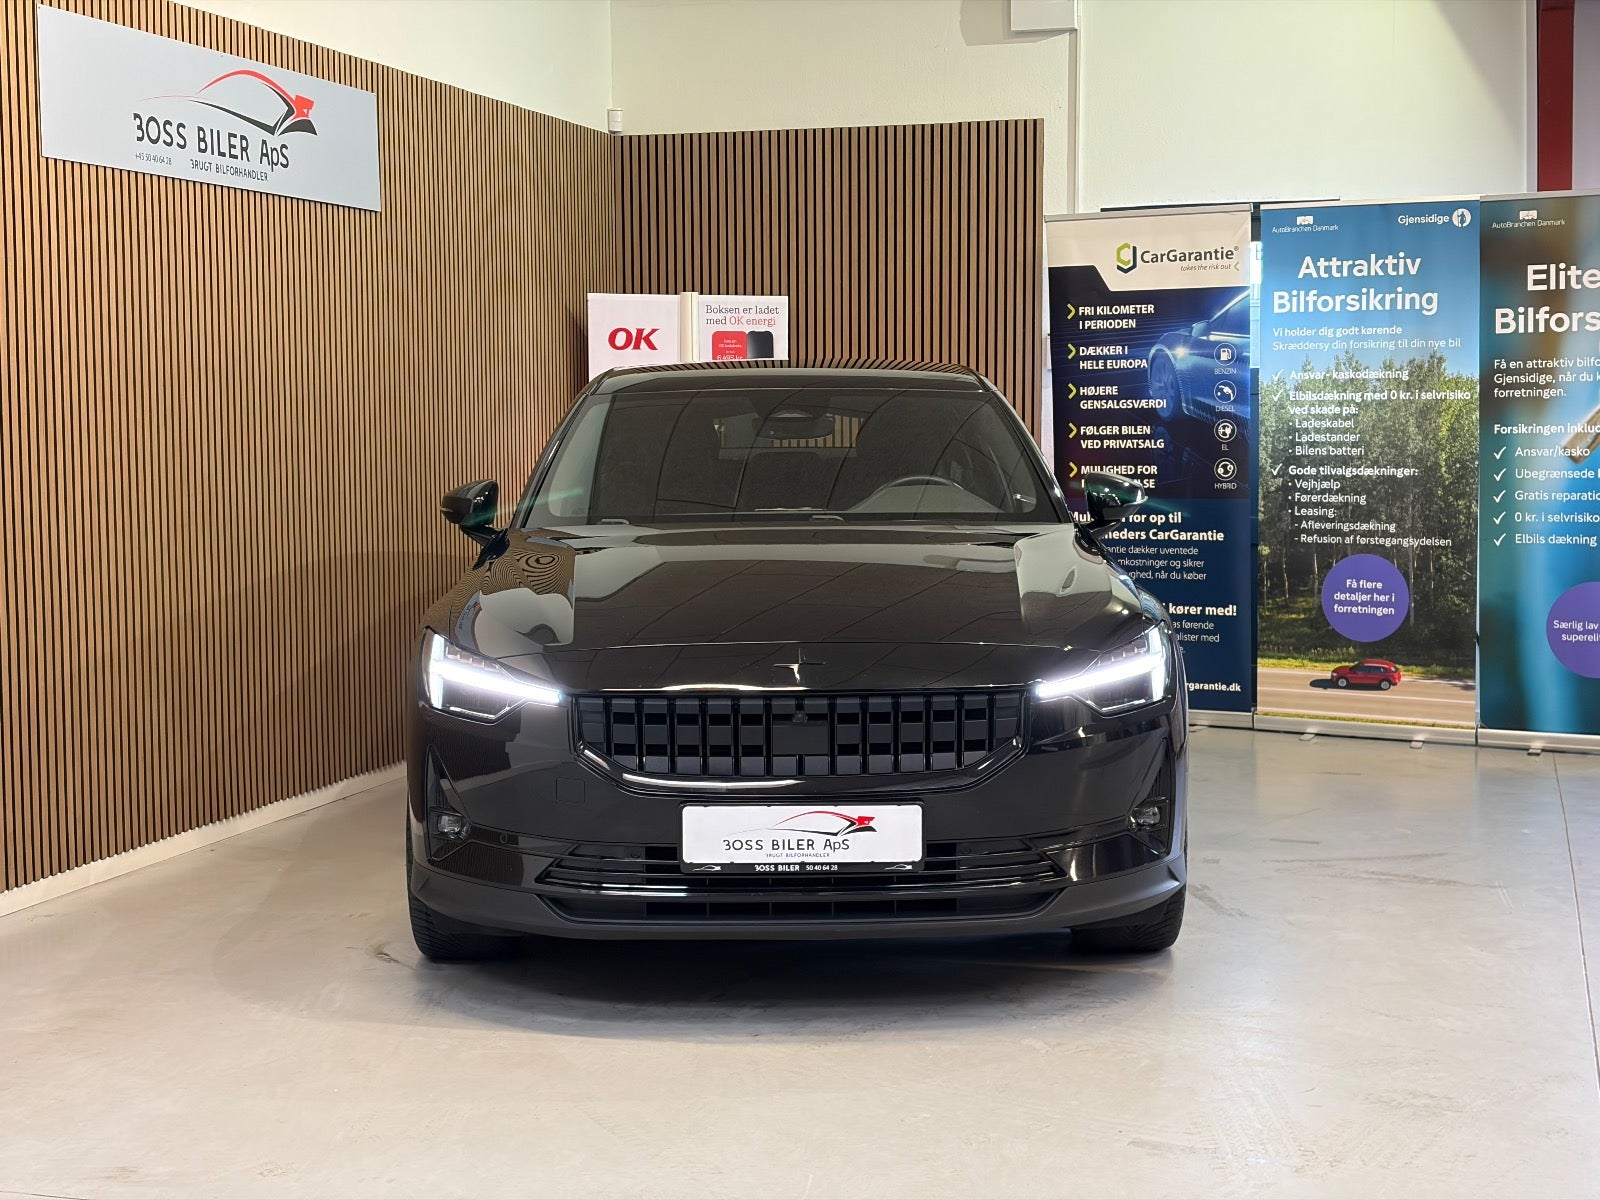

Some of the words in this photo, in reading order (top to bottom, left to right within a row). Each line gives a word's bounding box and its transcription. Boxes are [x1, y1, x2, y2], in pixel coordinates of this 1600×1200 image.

[197, 126, 250, 162] BILER
[260, 139, 289, 172] ApS
[216, 164, 268, 182] BILFORHANDLER
[1398, 214, 1449, 225] Gjensidige
[1537, 219, 1565, 227] Danmark
[1181, 264, 1197, 272] takes
[1298, 252, 1421, 278] Attraktiv
[1527, 262, 1600, 291] Elite
[1273, 287, 1438, 316] Bilforsikring
[706, 305, 740, 314] Boksen
[755, 305, 779, 314] ladet
[1079, 306, 1094, 316] FRI
[1097, 304, 1154, 315] KILOMETER
[706, 316, 727, 325] med
[729, 316, 744, 325] OK
[746, 316, 776, 327] energi
[1079, 321, 1082, 330] I
[1084, 319, 1136, 330] PERIODEN
[1495, 306, 1600, 334] Bilfors
[1272, 328, 1283, 337] Vi
[1285, 327, 1316, 336] holder
[1319, 327, 1334, 337] dig
[1336, 326, 1359, 337] godt
[1361, 325, 1402, 335] kørende
[608, 327, 660, 350] OK
[1273, 341, 1329, 352] Skræddersy
[1332, 340, 1347, 349] din
[1350, 339, 1395, 350] forsikring
[1398, 338, 1407, 348] til
[1411, 338, 1425, 347] din
[1428, 340, 1445, 350] nye
[1449, 338, 1461, 347] bil
[1079, 346, 1123, 356] DÆKKER
[1125, 346, 1128, 355] I
[1080, 360, 1104, 370] HELE
[1107, 359, 1148, 369] EUROPA
[1494, 359, 1506, 369] Få
[1509, 361, 1523, 369] en
[1526, 358, 1574, 368] attraktiv
[1332, 370, 1409, 380] kaskodækning
[1494, 373, 1556, 385] Gjensidige,
[1559, 371, 1576, 382] når
[1579, 371, 1593, 381] du
[1080, 386, 1118, 396] HØJERE
[1290, 391, 1361, 402] Elbilsdækning
[1364, 392, 1388, 400] med
[1400, 391, 1413, 400] kr.
[1415, 391, 1419, 399] i
[1421, 391, 1471, 400] selvrisiko
[1494, 387, 1566, 399] forretningen.
[1080, 399, 1167, 410] GENSALGSVÆRDI
[1289, 405, 1308, 415] ved
[1310, 405, 1340, 415] skade
[1343, 405, 1358, 416] på:
[1296, 419, 1354, 428] Ladeskabel
[1494, 423, 1564, 435] Forsikringen
[1080, 425, 1119, 436] FØLGER
[1122, 426, 1150, 435] BILEN
[1296, 433, 1360, 442] Ladestander
[1081, 439, 1101, 449] VED
[1104, 439, 1164, 449] PRIVATSALG
[1296, 446, 1327, 456] Bilens
[1330, 446, 1364, 456] batteri
[1515, 446, 1590, 458] Ansvar/kasko
[1138, 465, 1158, 475] FOR
[1289, 466, 1317, 476] Gode
[1320, 466, 1418, 478] tilvalgsdækninger:
[1515, 468, 1594, 481] Ubegrænsede
[1295, 479, 1340, 490] Vejhjælp
[1295, 493, 1366, 505] Førerdækning
[1515, 491, 1548, 501] Gratis
[1295, 507, 1337, 517] Leasing:
[1515, 513, 1522, 522] 0
[1525, 512, 1538, 522] kr.
[1542, 512, 1545, 522] i
[1149, 513, 1165, 525] op
[1169, 512, 1181, 523] til
[1301, 520, 1396, 532] Afleveringsdækning
[1149, 529, 1224, 541] CarGarantie
[1301, 534, 1342, 544] Refusion
[1344, 535, 1354, 544] af
[1356, 536, 1451, 547] førstegangsydelsen
[1515, 534, 1545, 544] Elbils
[1548, 534, 1597, 547] dækning
[1128, 545, 1158, 554] dækker
[1160, 546, 1198, 555] uventede
[1118, 558, 1168, 569] mkostninger
[1170, 560, 1180, 568] og
[1183, 558, 1204, 567] sikrer
[1155, 570, 1168, 580] når
[1170, 570, 1181, 580] du
[1183, 571, 1207, 580] køber
[1346, 579, 1357, 588] Få
[1360, 580, 1382, 589] flere
[1334, 592, 1371, 602] detaljer
[1374, 593, 1390, 602] her
[1392, 593, 1395, 602] i
[1169, 603, 1202, 614] kører
[1205, 605, 1237, 616] med!
[1334, 604, 1395, 616] forretningen
[1182, 620, 1214, 629] førende
[1553, 620, 1583, 631] Særlig
[1586, 621, 1598, 630] lav
[1200, 634, 1220, 642] med
[772, 838, 815, 850] BILER
[823, 838, 850, 852] ApS
